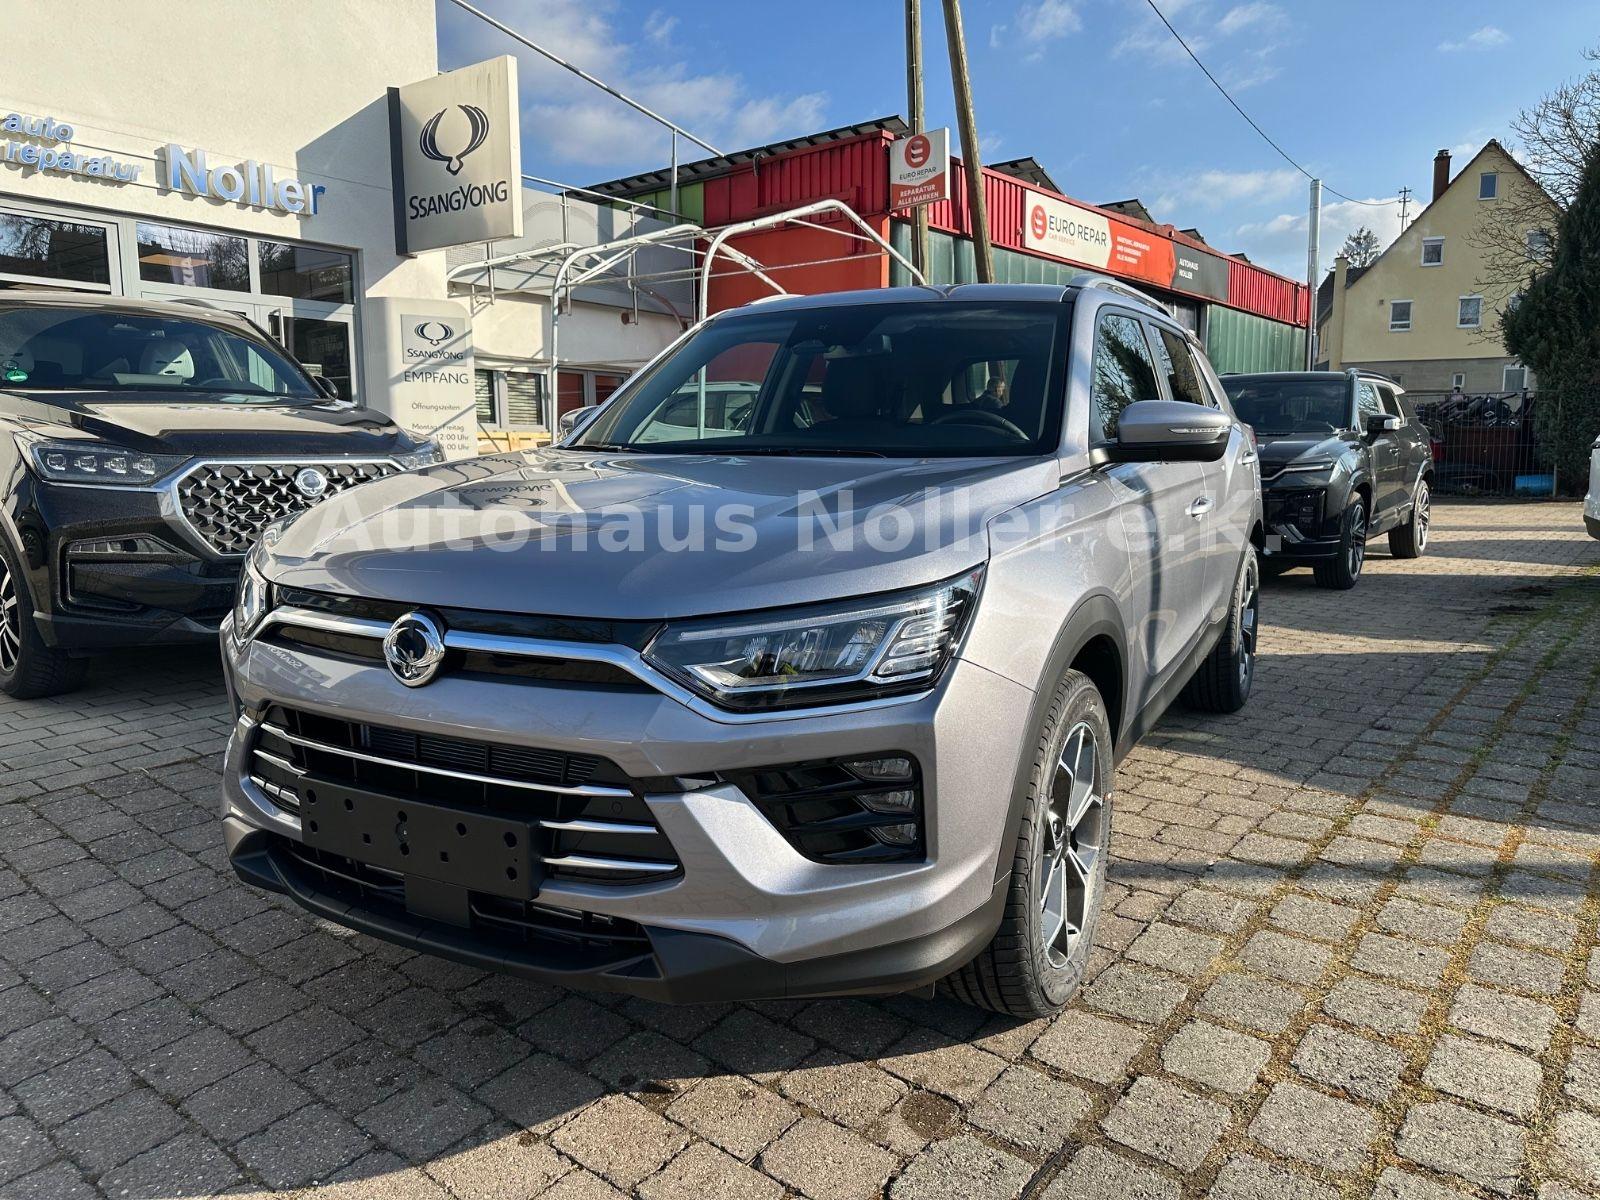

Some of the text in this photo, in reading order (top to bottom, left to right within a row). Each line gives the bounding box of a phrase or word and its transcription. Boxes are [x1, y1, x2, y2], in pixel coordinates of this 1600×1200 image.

[4, 113, 74, 142] auto
[7, 142, 144, 182] reparatur
[165, 143, 326, 216] Noller
[900, 171, 916, 180] EURO
[917, 167, 937, 176] REPAR
[409, 181, 508, 220] SSANGYONG
[897, 191, 939, 206] ALLE MARKEN
[900, 185, 936, 197] REPARATUR
[1048, 215, 1076, 236] EURO
[1077, 224, 1107, 247] REPAR
[1179, 258, 1200, 271] AUTOHAUS
[404, 371, 469, 384] EMPFANG
